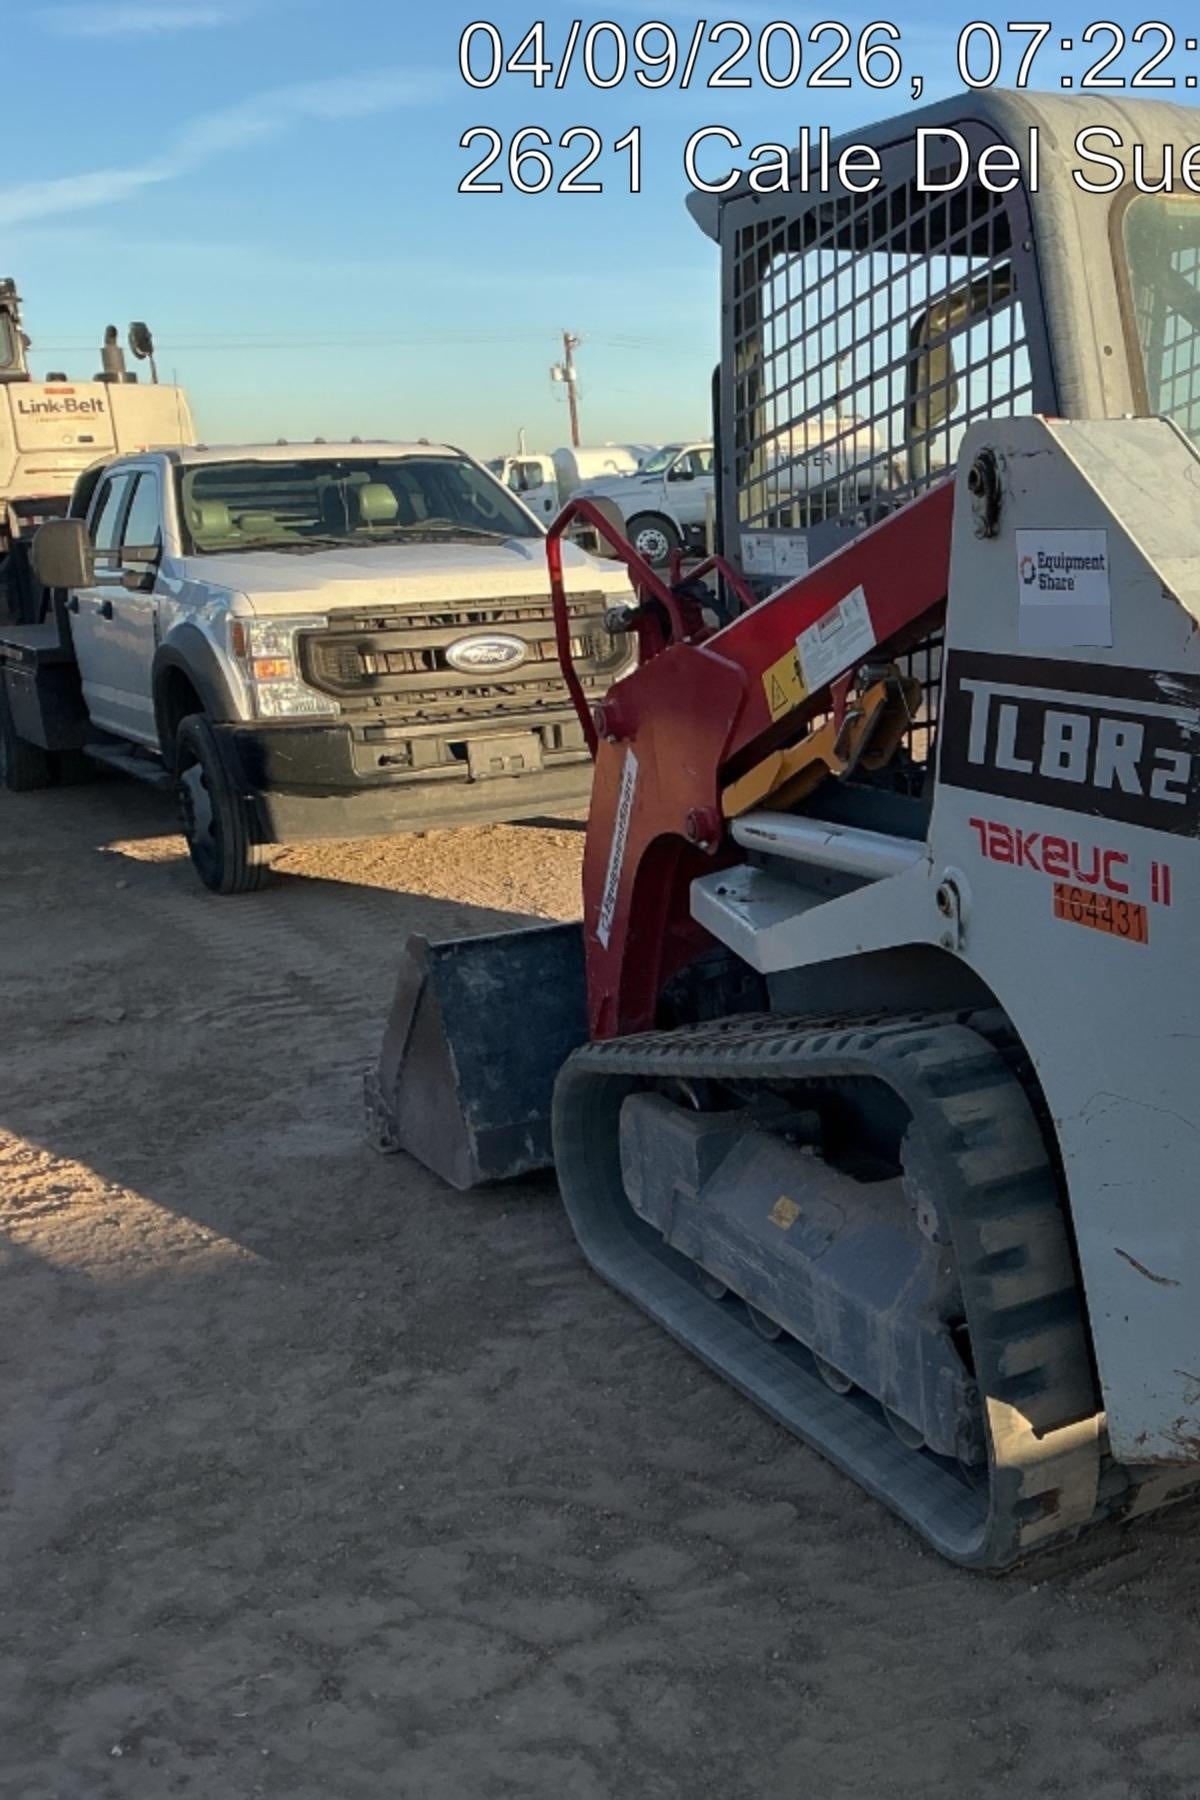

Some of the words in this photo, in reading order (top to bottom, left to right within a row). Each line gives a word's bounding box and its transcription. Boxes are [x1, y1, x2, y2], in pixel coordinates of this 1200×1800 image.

[17, 398, 105, 414] Link-Belt
[1037, 551, 1105, 574] Equipment
[1037, 573, 1075, 591] Share
[1054, 884, 1145, 942] 164431
